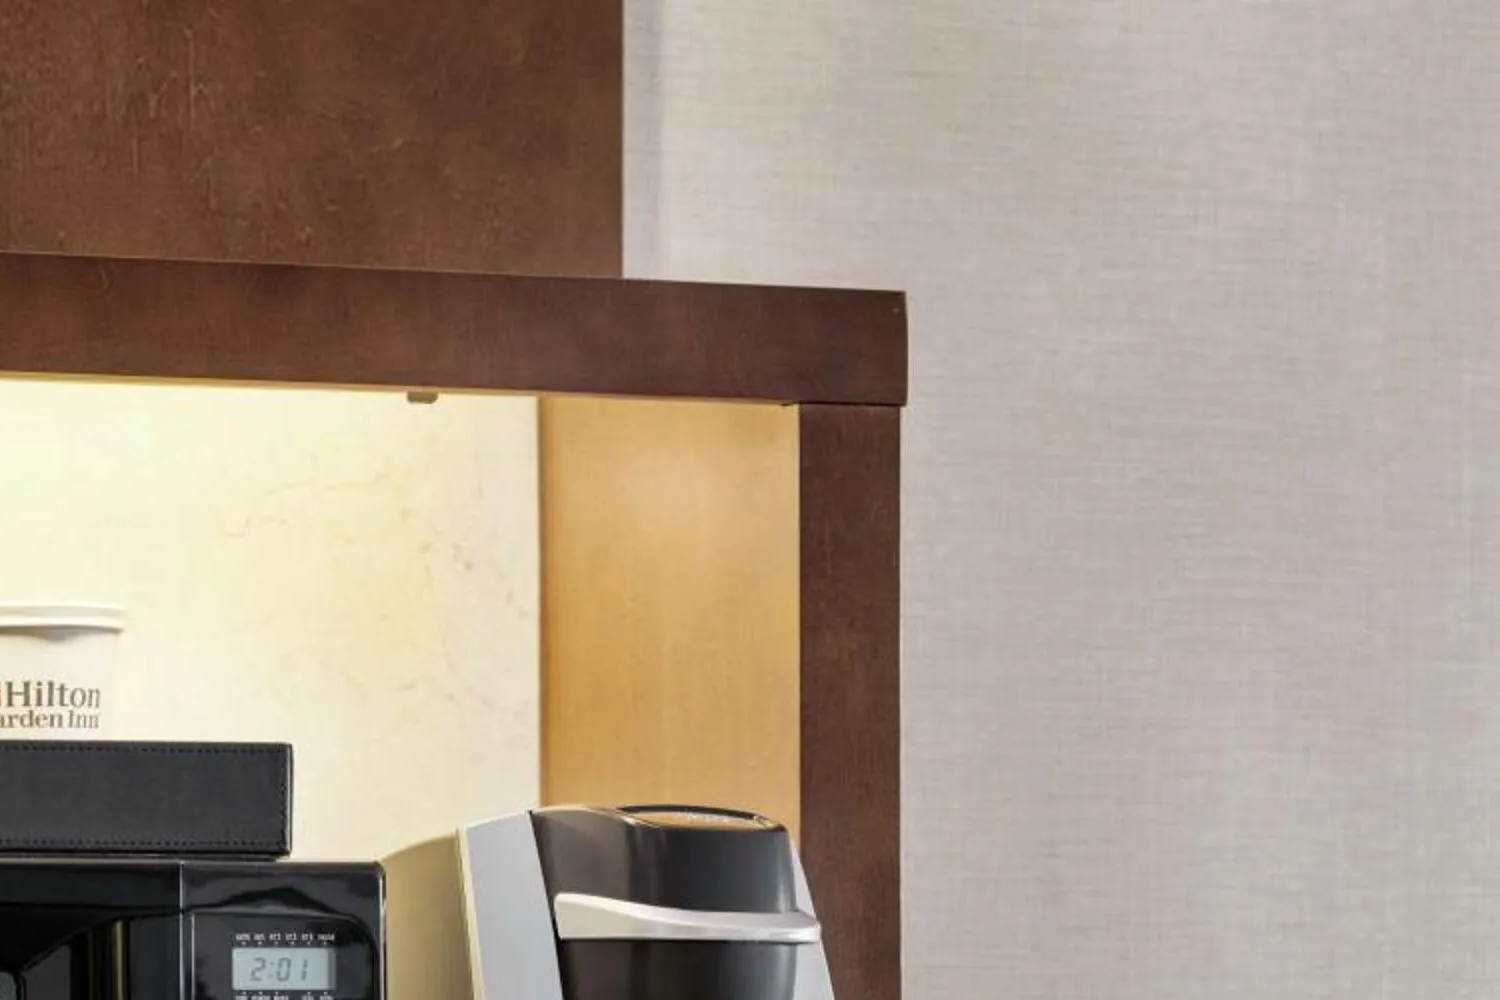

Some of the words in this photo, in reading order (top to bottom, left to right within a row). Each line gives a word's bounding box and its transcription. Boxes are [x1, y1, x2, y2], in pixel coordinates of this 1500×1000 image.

[5, 680, 101, 708] Hilton
[67, 709, 100, 729] Inn
[250, 956, 309, 982] 2:01
